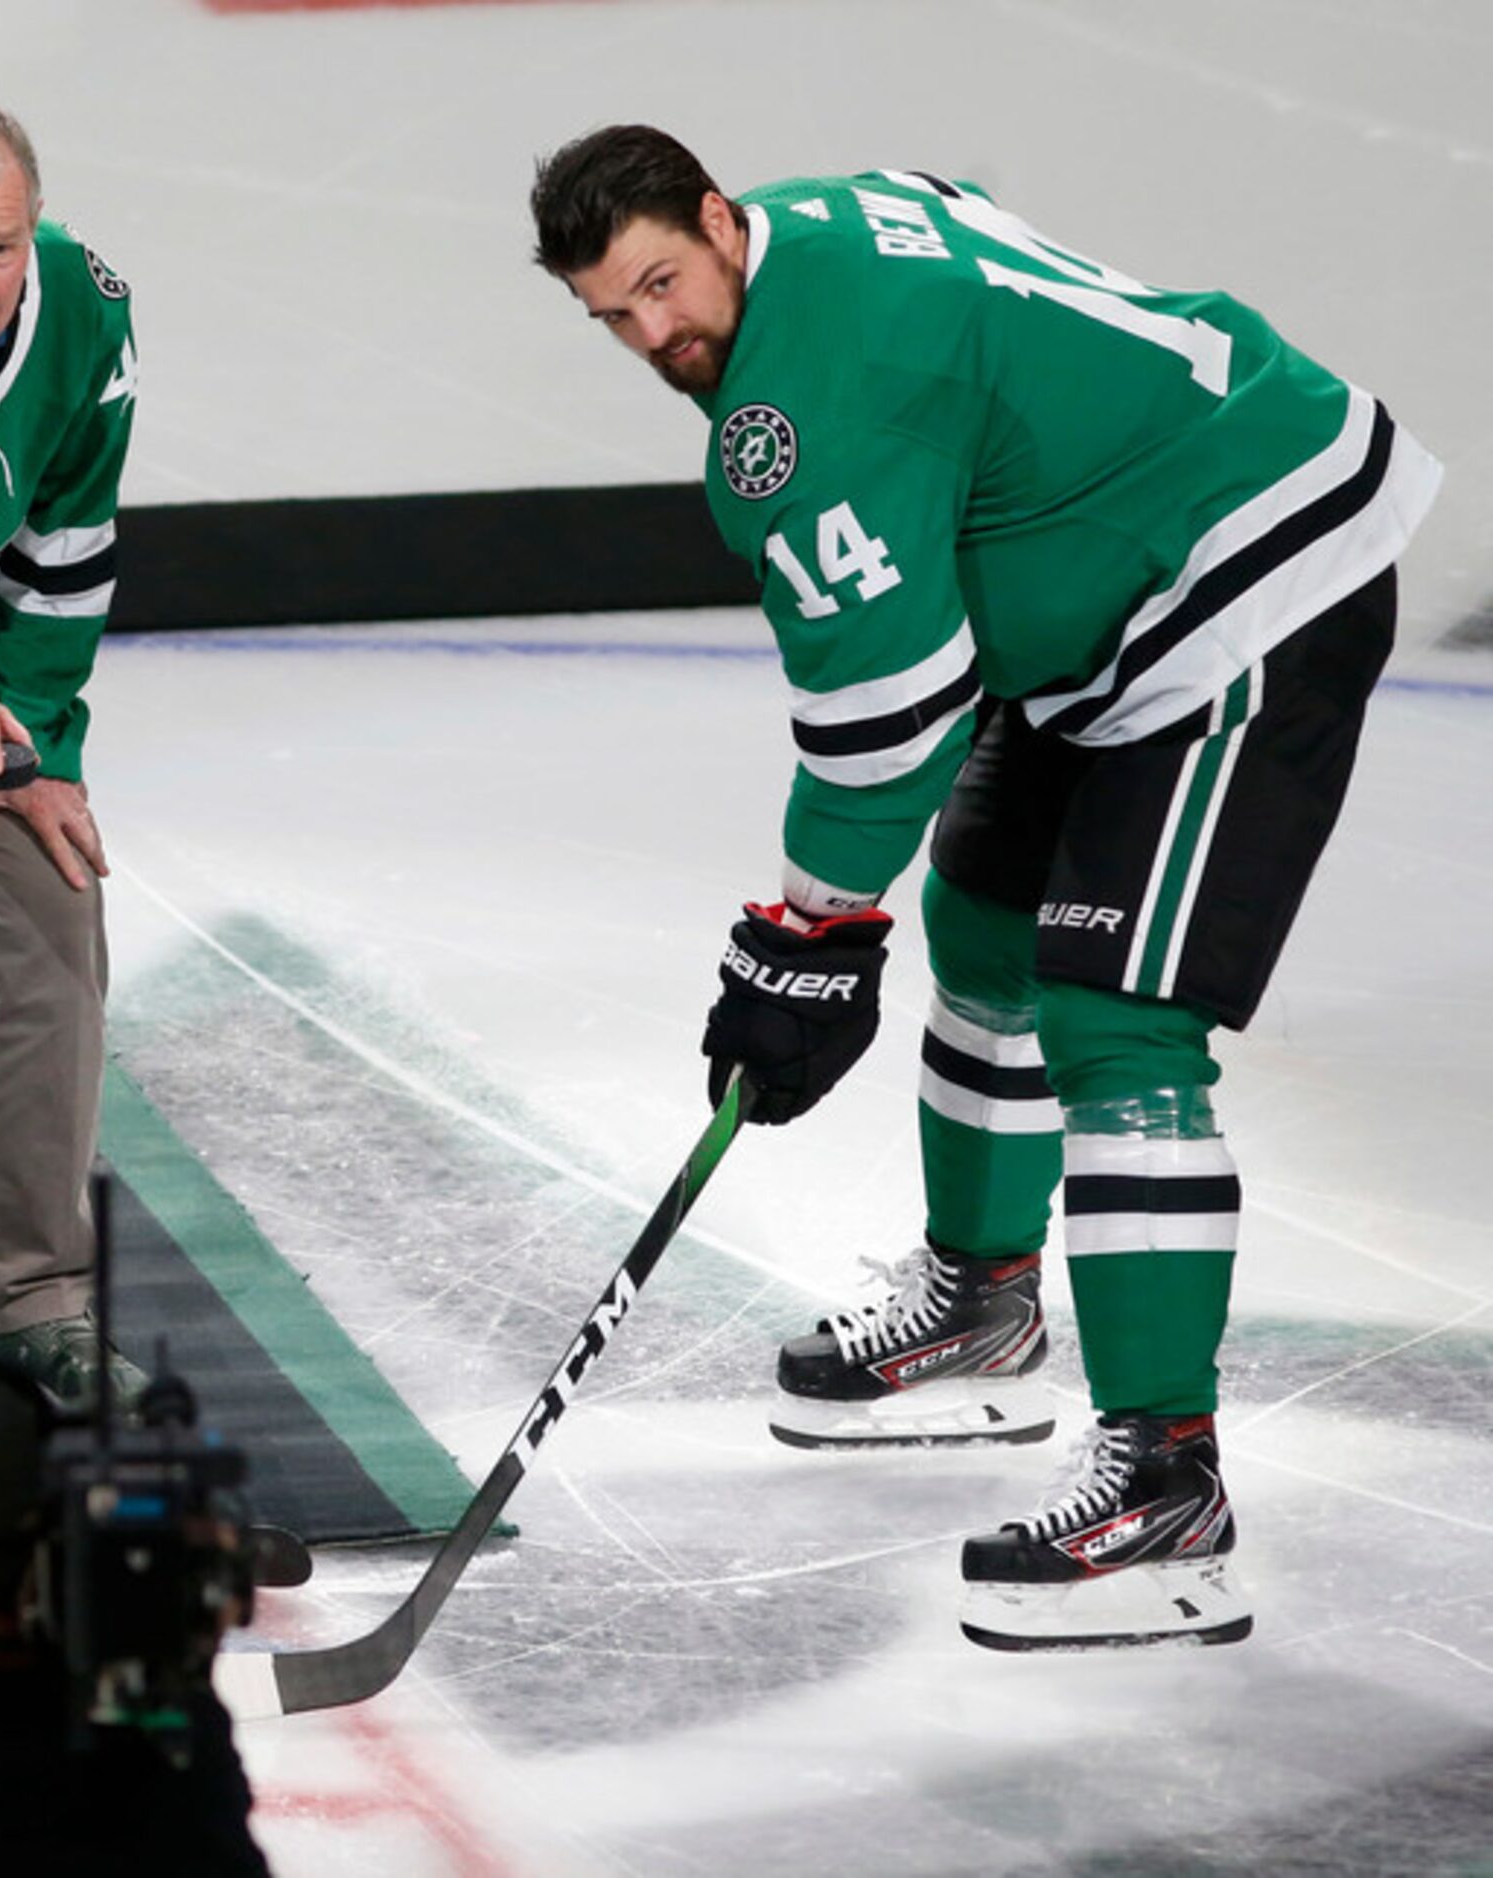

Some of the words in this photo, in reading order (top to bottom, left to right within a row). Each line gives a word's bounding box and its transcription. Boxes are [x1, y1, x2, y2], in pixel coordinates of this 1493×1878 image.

[765, 500, 903, 619] 14
[508, 1267, 638, 1467] CCM
[898, 1342, 961, 1377] CCM
[1084, 1515, 1144, 1557] CCM
